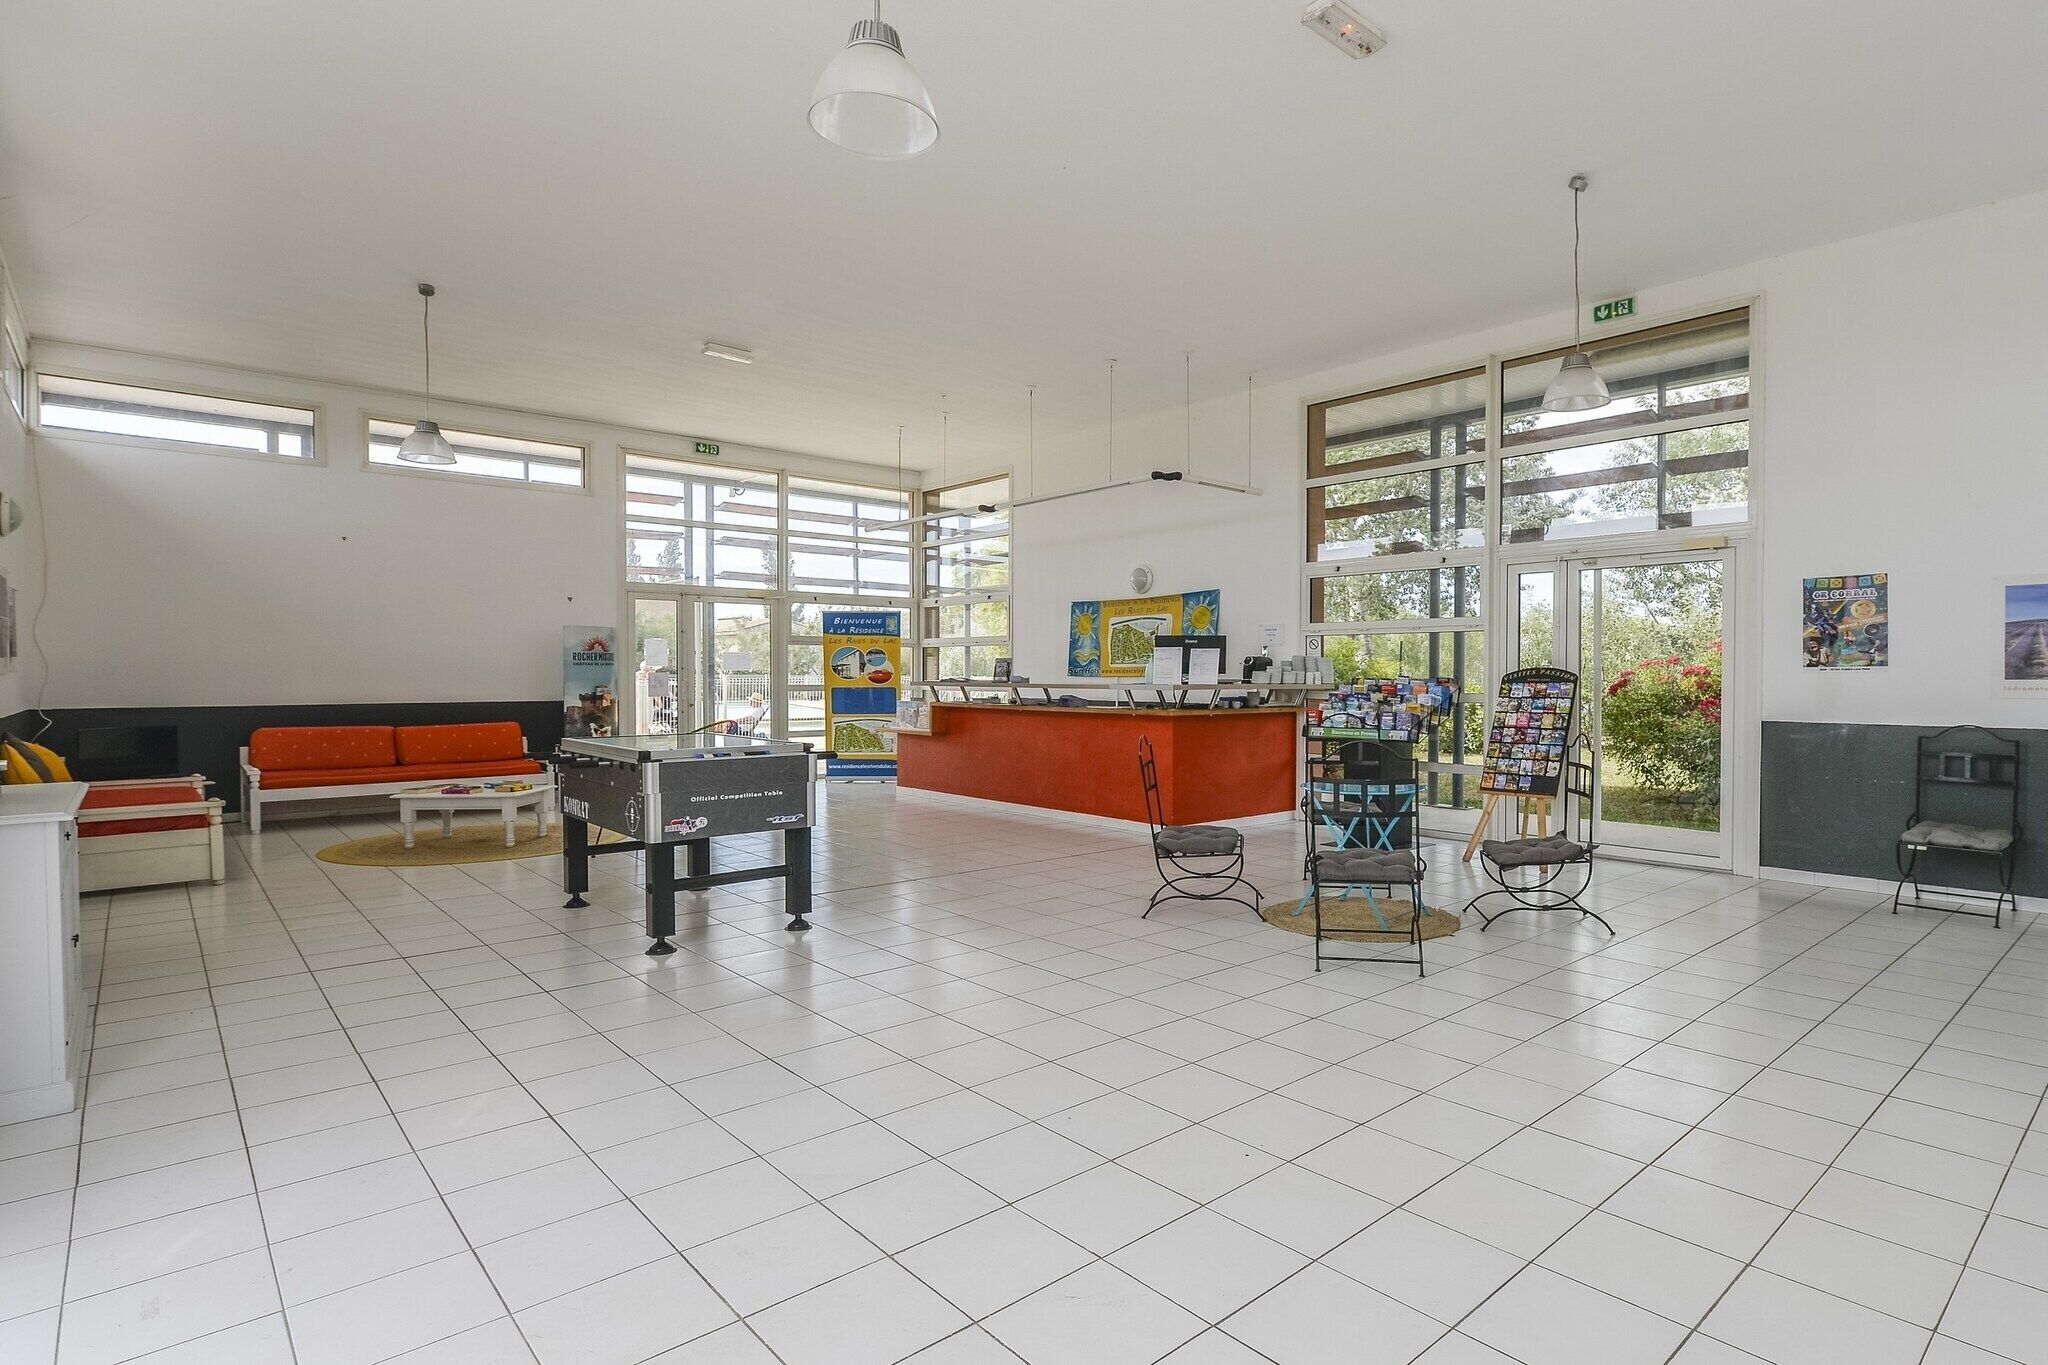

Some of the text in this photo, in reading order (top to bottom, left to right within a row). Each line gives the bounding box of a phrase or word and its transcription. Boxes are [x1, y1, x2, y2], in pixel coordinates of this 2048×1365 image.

[1813, 588, 1878, 599] OK CORRAL
[833, 617, 883, 625] BIENVENUE
[572, 652, 598, 661] ROCHER
[1503, 670, 1577, 681] VISITES PASSION
[690, 795, 718, 803] Official
[720, 792, 762, 801] Competition
